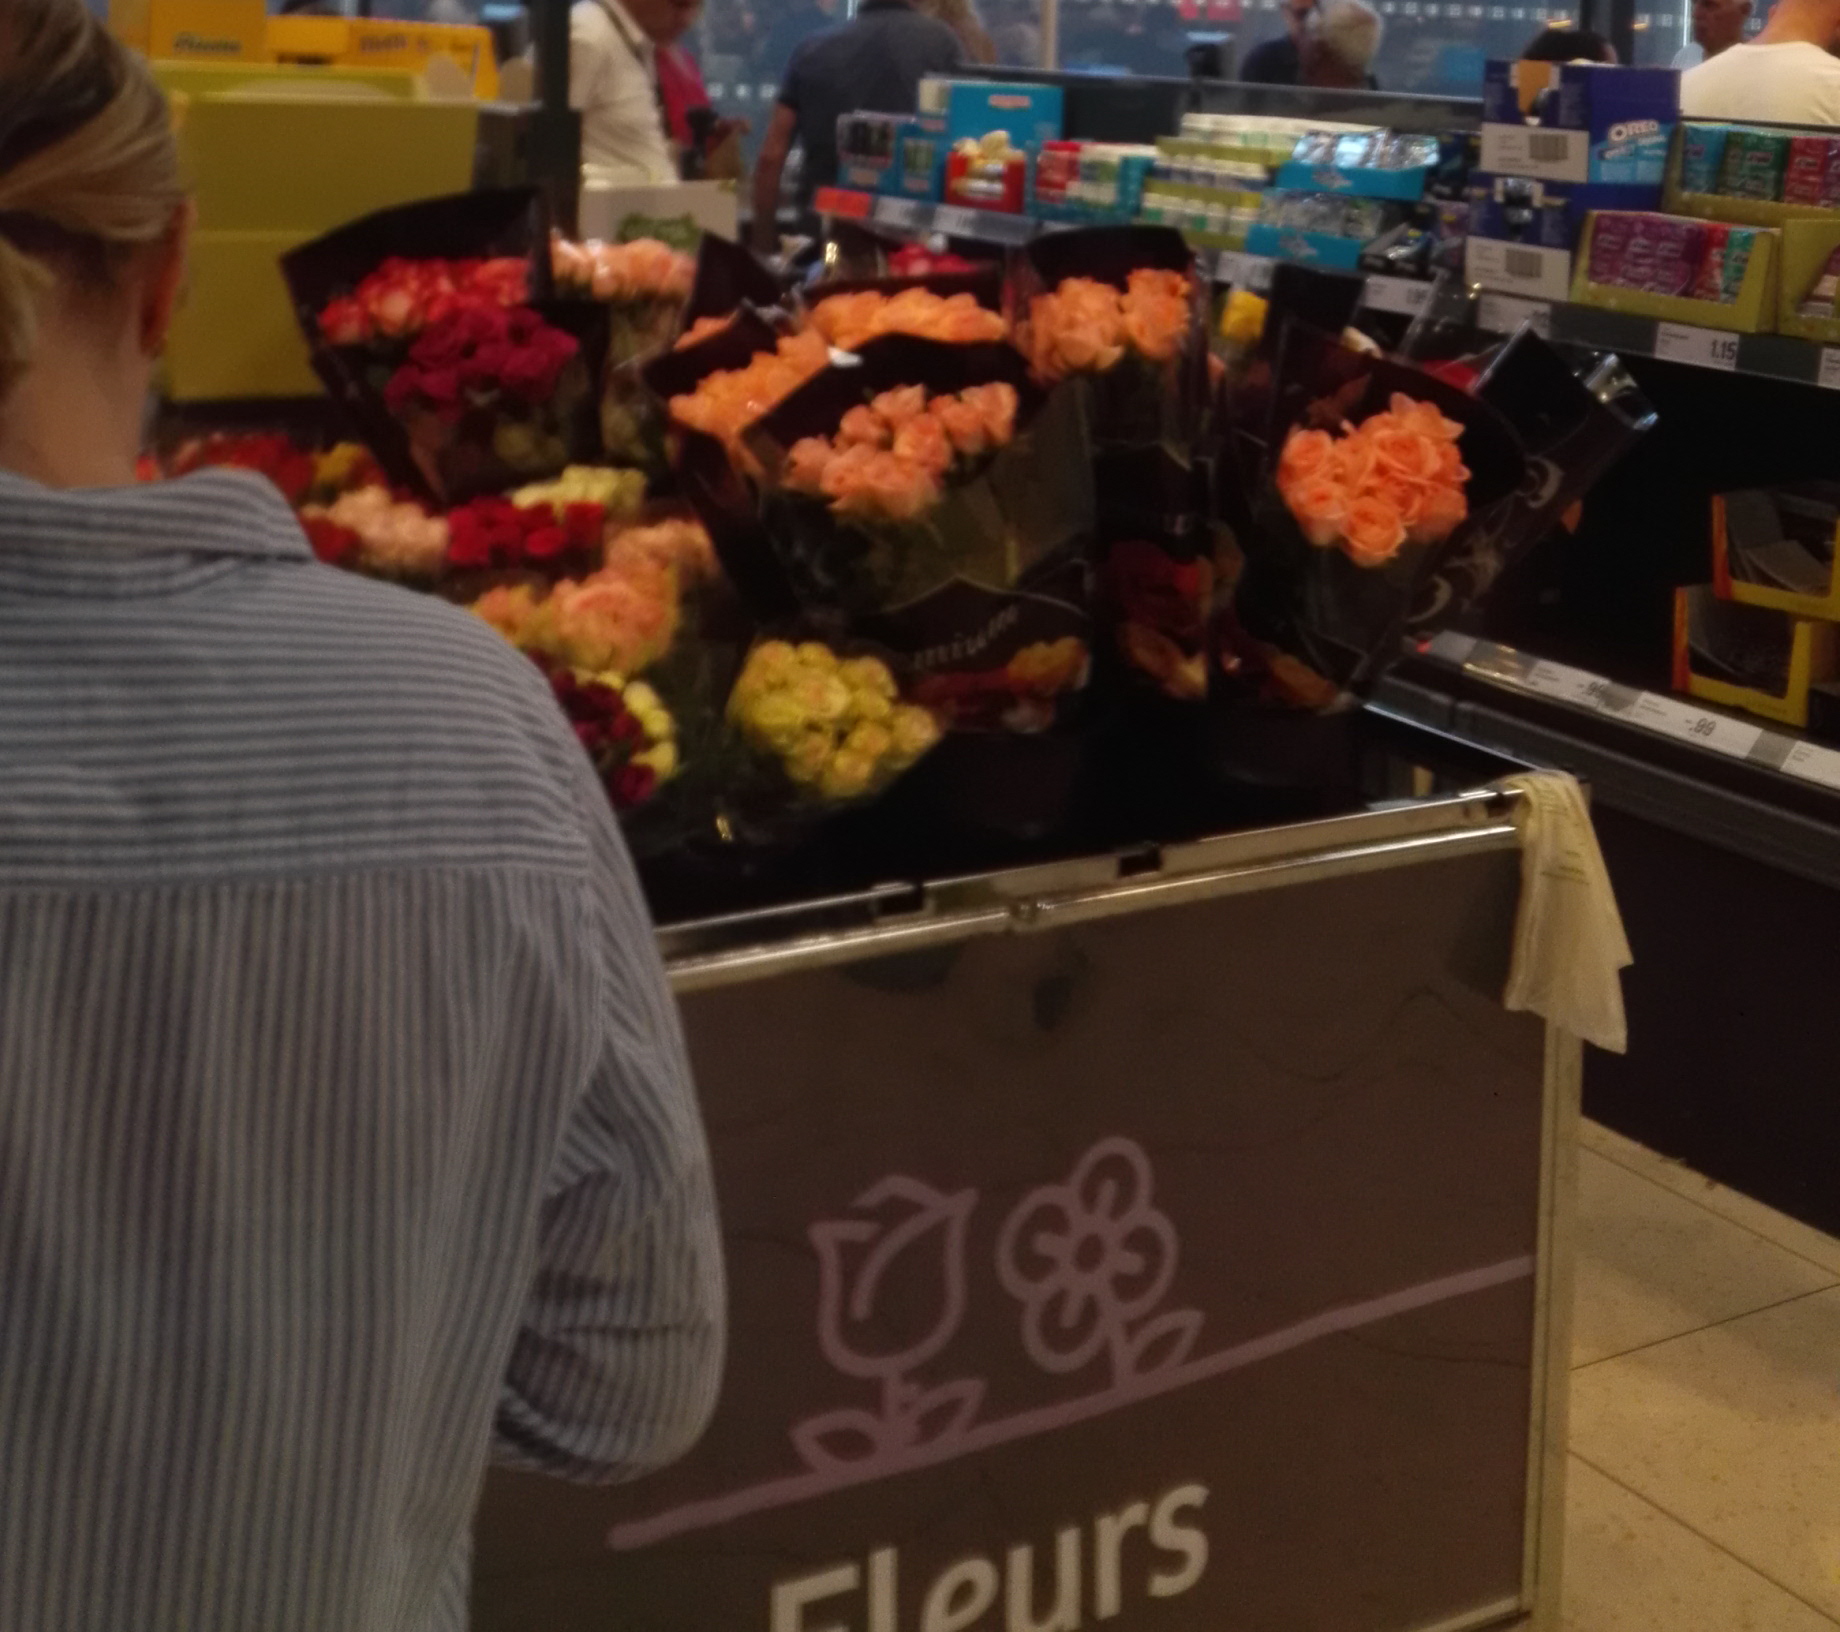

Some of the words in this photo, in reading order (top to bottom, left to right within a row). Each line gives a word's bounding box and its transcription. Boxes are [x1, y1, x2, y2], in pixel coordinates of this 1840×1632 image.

[1608, 119, 1659, 143] OREO
[1711, 340, 1737, 360] 1.15
[769, 1484, 1210, 1632] Fleurs
